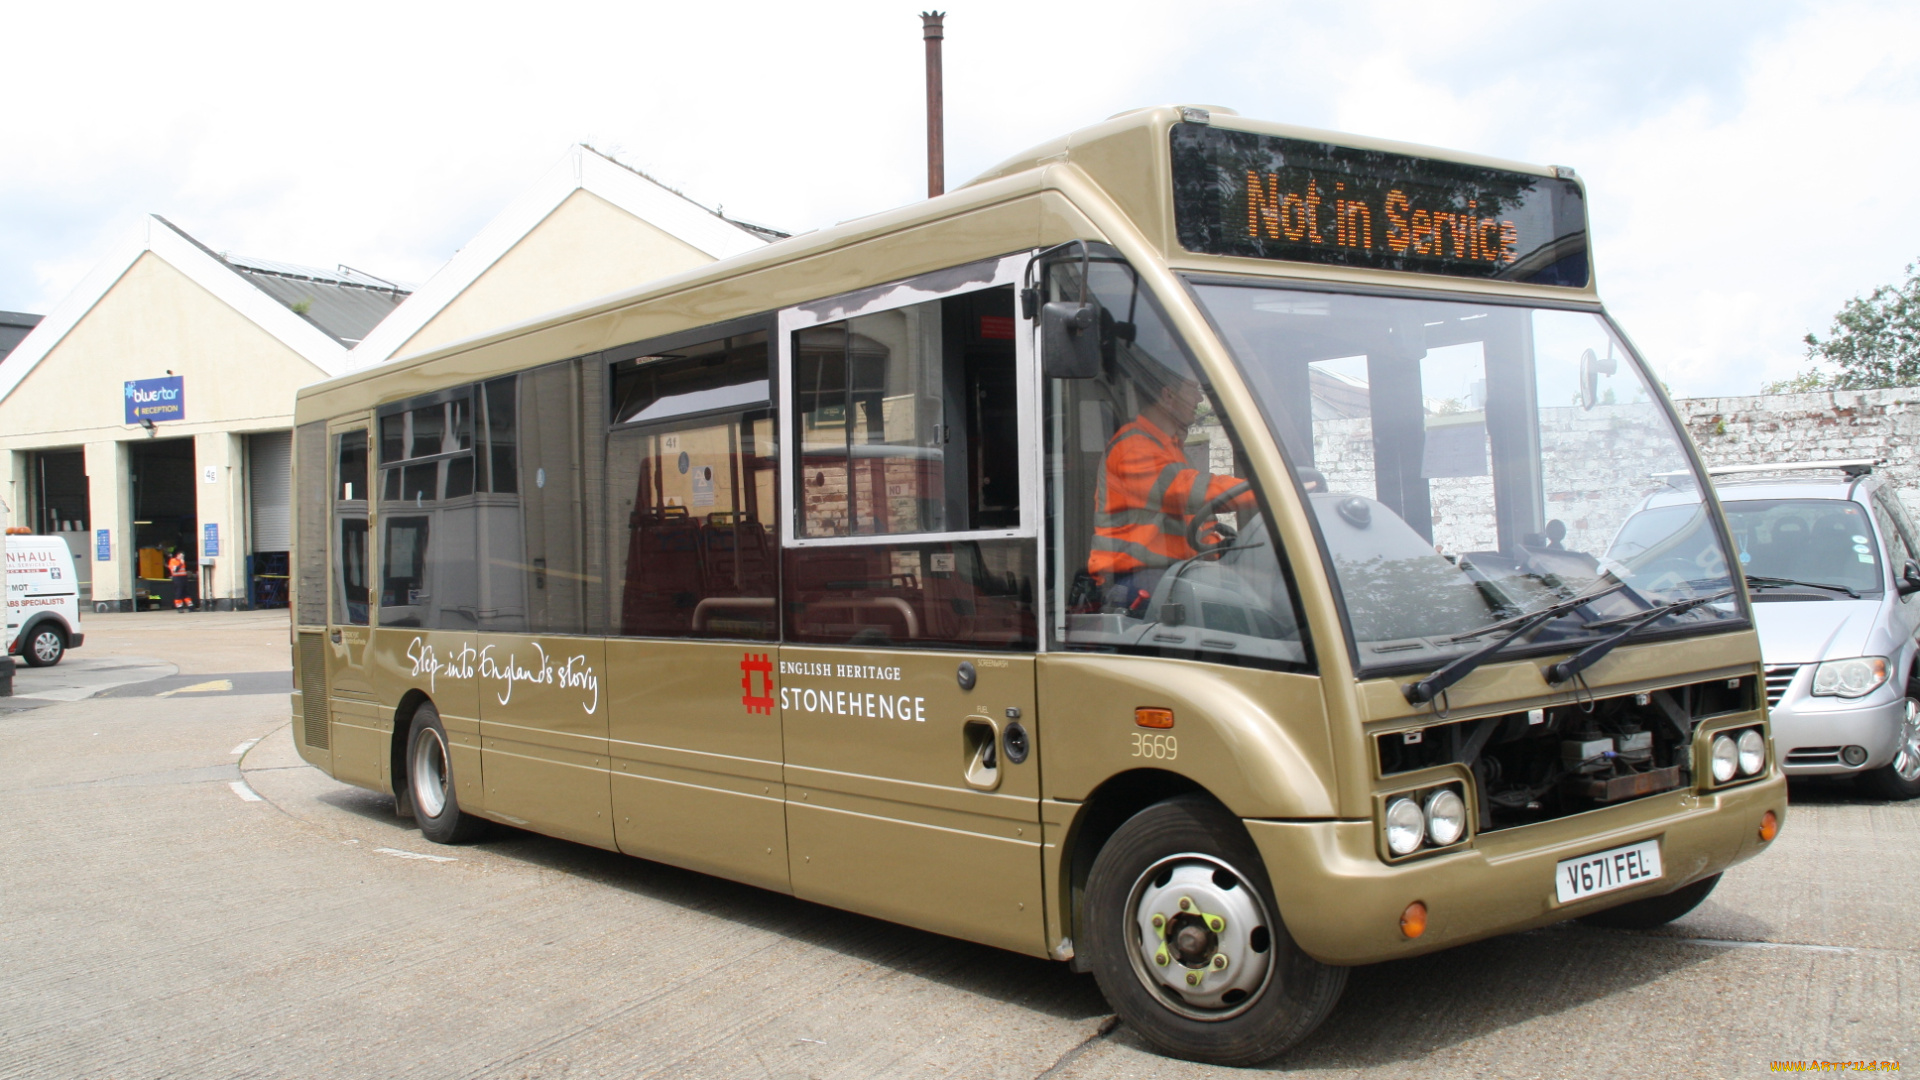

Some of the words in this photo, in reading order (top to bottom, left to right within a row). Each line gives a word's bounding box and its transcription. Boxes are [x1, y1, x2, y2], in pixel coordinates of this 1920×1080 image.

[1247, 170, 1322, 243] Not
[1336, 182, 1372, 249] in
[1384, 189, 1518, 263] Service
[134, 386, 179, 403] bluestar
[141, 405, 178, 415] RECEPTION
[21, 598, 65, 606] SPECIALISTS
[406, 636, 444, 693] Step
[444, 641, 476, 679] into
[478, 642, 553, 705] England's
[558, 654, 597, 714] story
[780, 661, 831, 677] ENGLISH
[836, 663, 901, 681] HERITAGE
[780, 687, 926, 722] STONEHENGE
[1131, 732, 1178, 760] 3669
